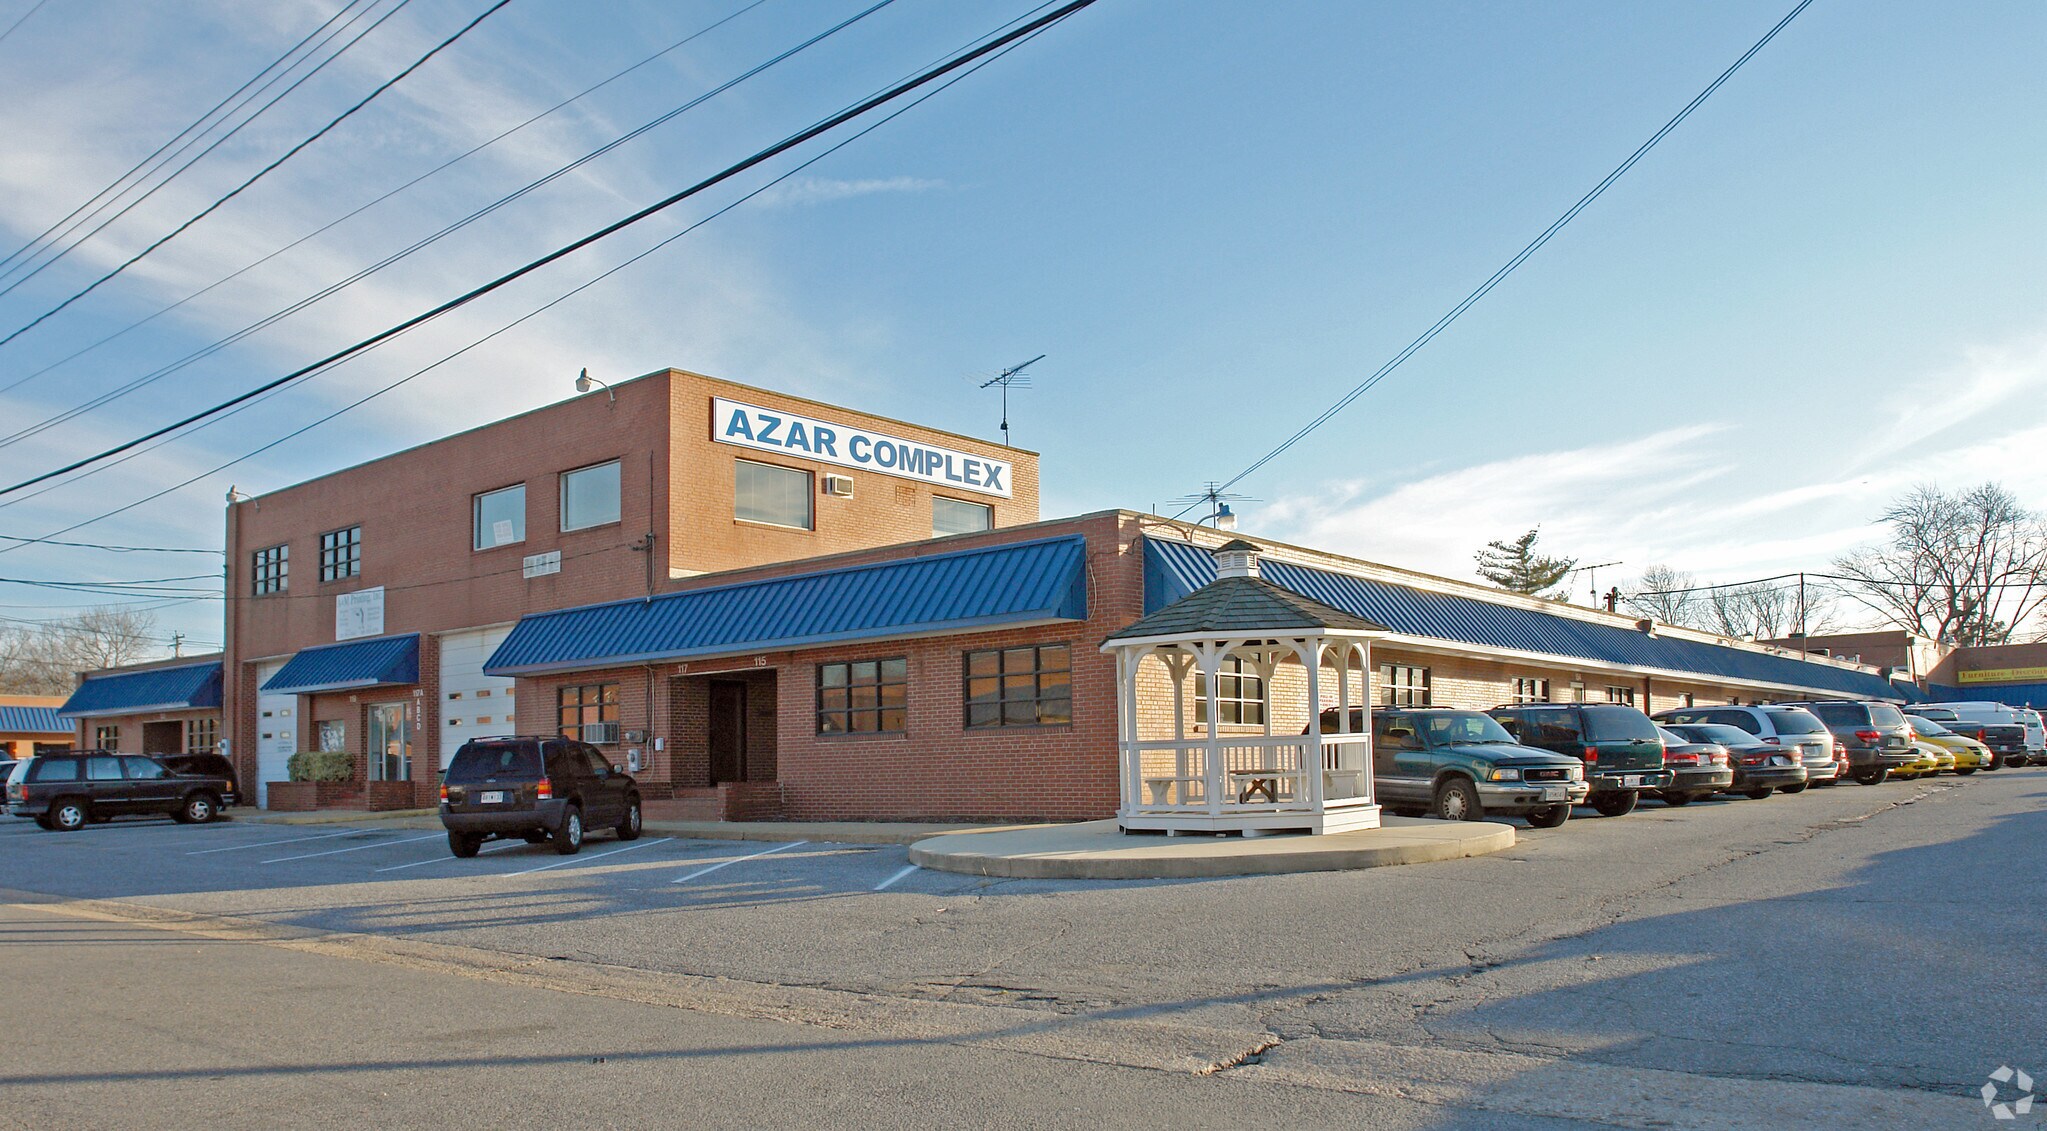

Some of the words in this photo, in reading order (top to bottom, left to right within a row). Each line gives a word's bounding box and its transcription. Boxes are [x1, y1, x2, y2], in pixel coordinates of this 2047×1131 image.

[725, 408, 838, 457] AZAR
[848, 434, 1004, 491] COMPLEX
[754, 656, 767, 666] 115
[678, 664, 689, 674] 117
